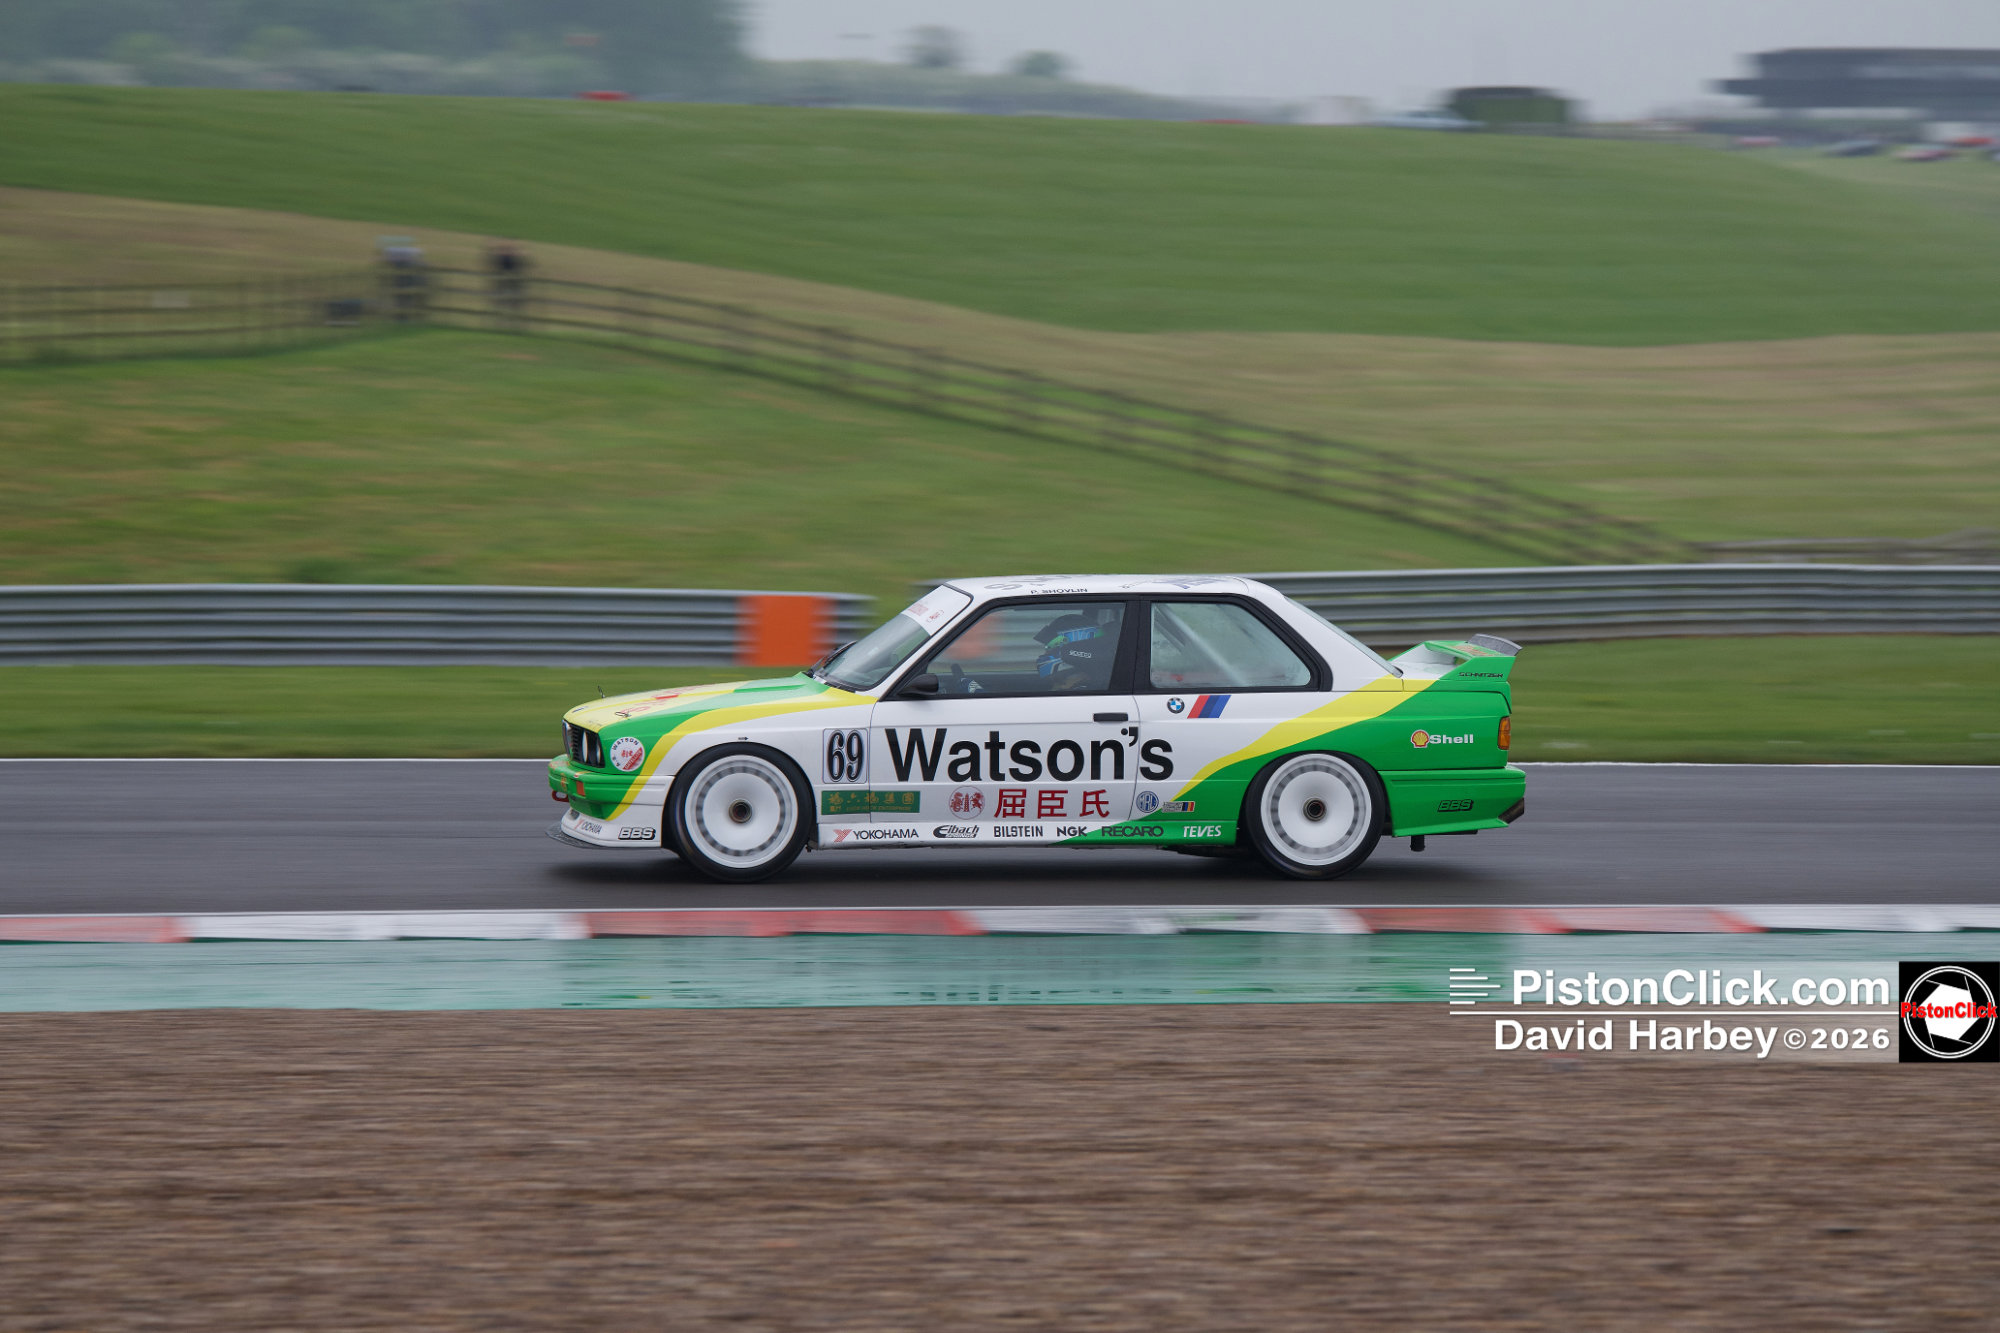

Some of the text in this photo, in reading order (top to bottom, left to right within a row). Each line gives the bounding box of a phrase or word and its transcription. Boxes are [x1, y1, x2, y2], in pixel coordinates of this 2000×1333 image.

[1041, 587, 1088, 595] SHOVLIN
[612, 737, 640, 751] WATSON
[1429, 733, 1474, 744] Shell
[826, 729, 864, 783] 69
[884, 726, 1174, 783] Watson's
[993, 788, 1110, 819] 屈臣氏
[1437, 799, 1475, 812] BBS
[618, 827, 656, 840] BBS
[853, 828, 919, 840] YOKOHAMA
[933, 825, 980, 838] Eibach
[993, 825, 1044, 838] BILSTEIN
[1056, 826, 1088, 837] NGK
[1101, 826, 1164, 837] RECARO
[1183, 825, 1222, 838] TEVES
